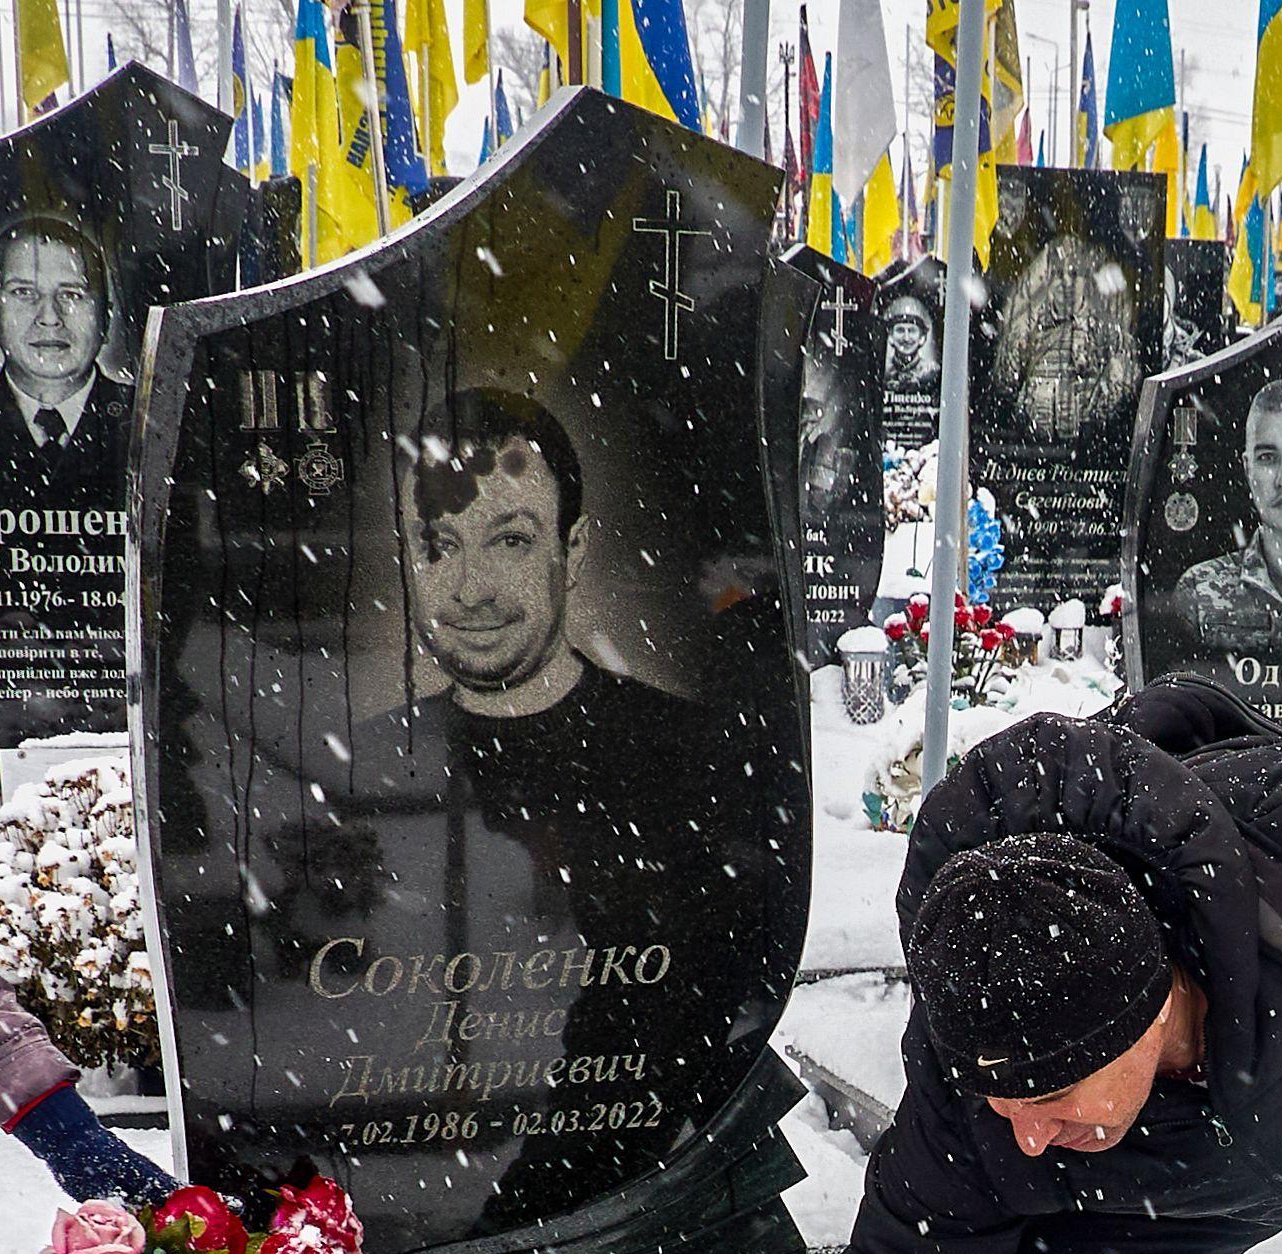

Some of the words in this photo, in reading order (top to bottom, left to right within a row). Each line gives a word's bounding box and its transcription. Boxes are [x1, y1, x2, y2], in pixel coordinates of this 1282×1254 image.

[46, 685, 80, 699] небо
[69, 669, 98, 679] вже
[309, 937, 672, 999] Соколенко
[414, 999, 568, 1051] Денис
[328, 1052, 647, 1108] Дмитриевич
[513, 1102, 663, 1136] 02.03.2022
